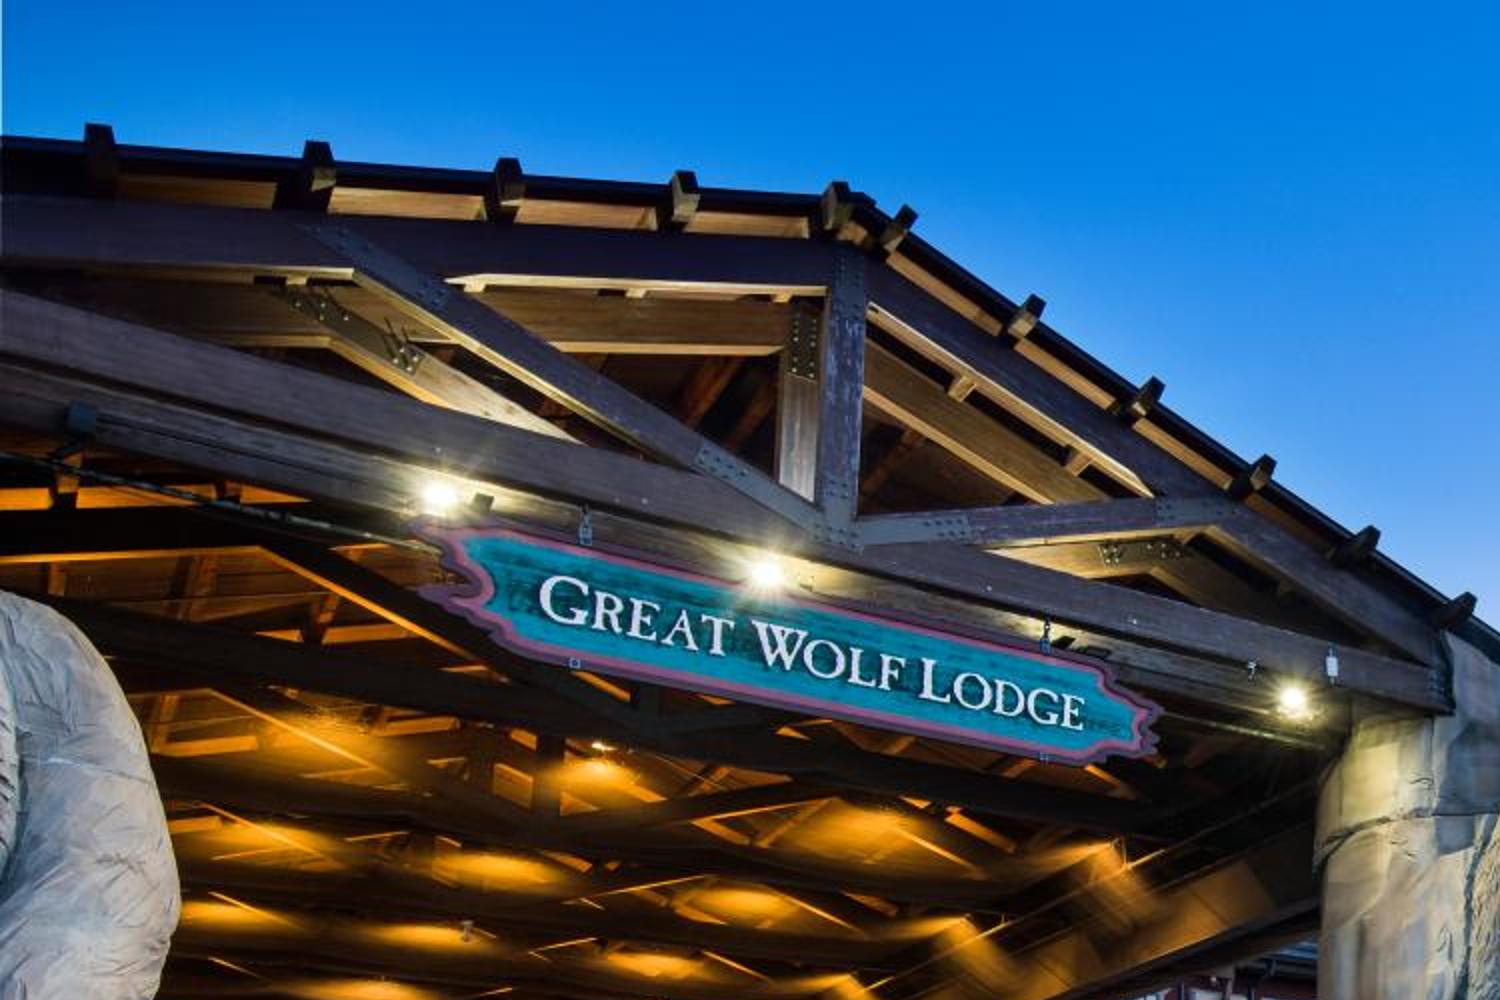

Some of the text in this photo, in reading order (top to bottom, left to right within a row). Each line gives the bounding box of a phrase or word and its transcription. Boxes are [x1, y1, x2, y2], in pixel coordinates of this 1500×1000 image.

[538, 575, 1086, 732] GREAT WOLF LODGE
